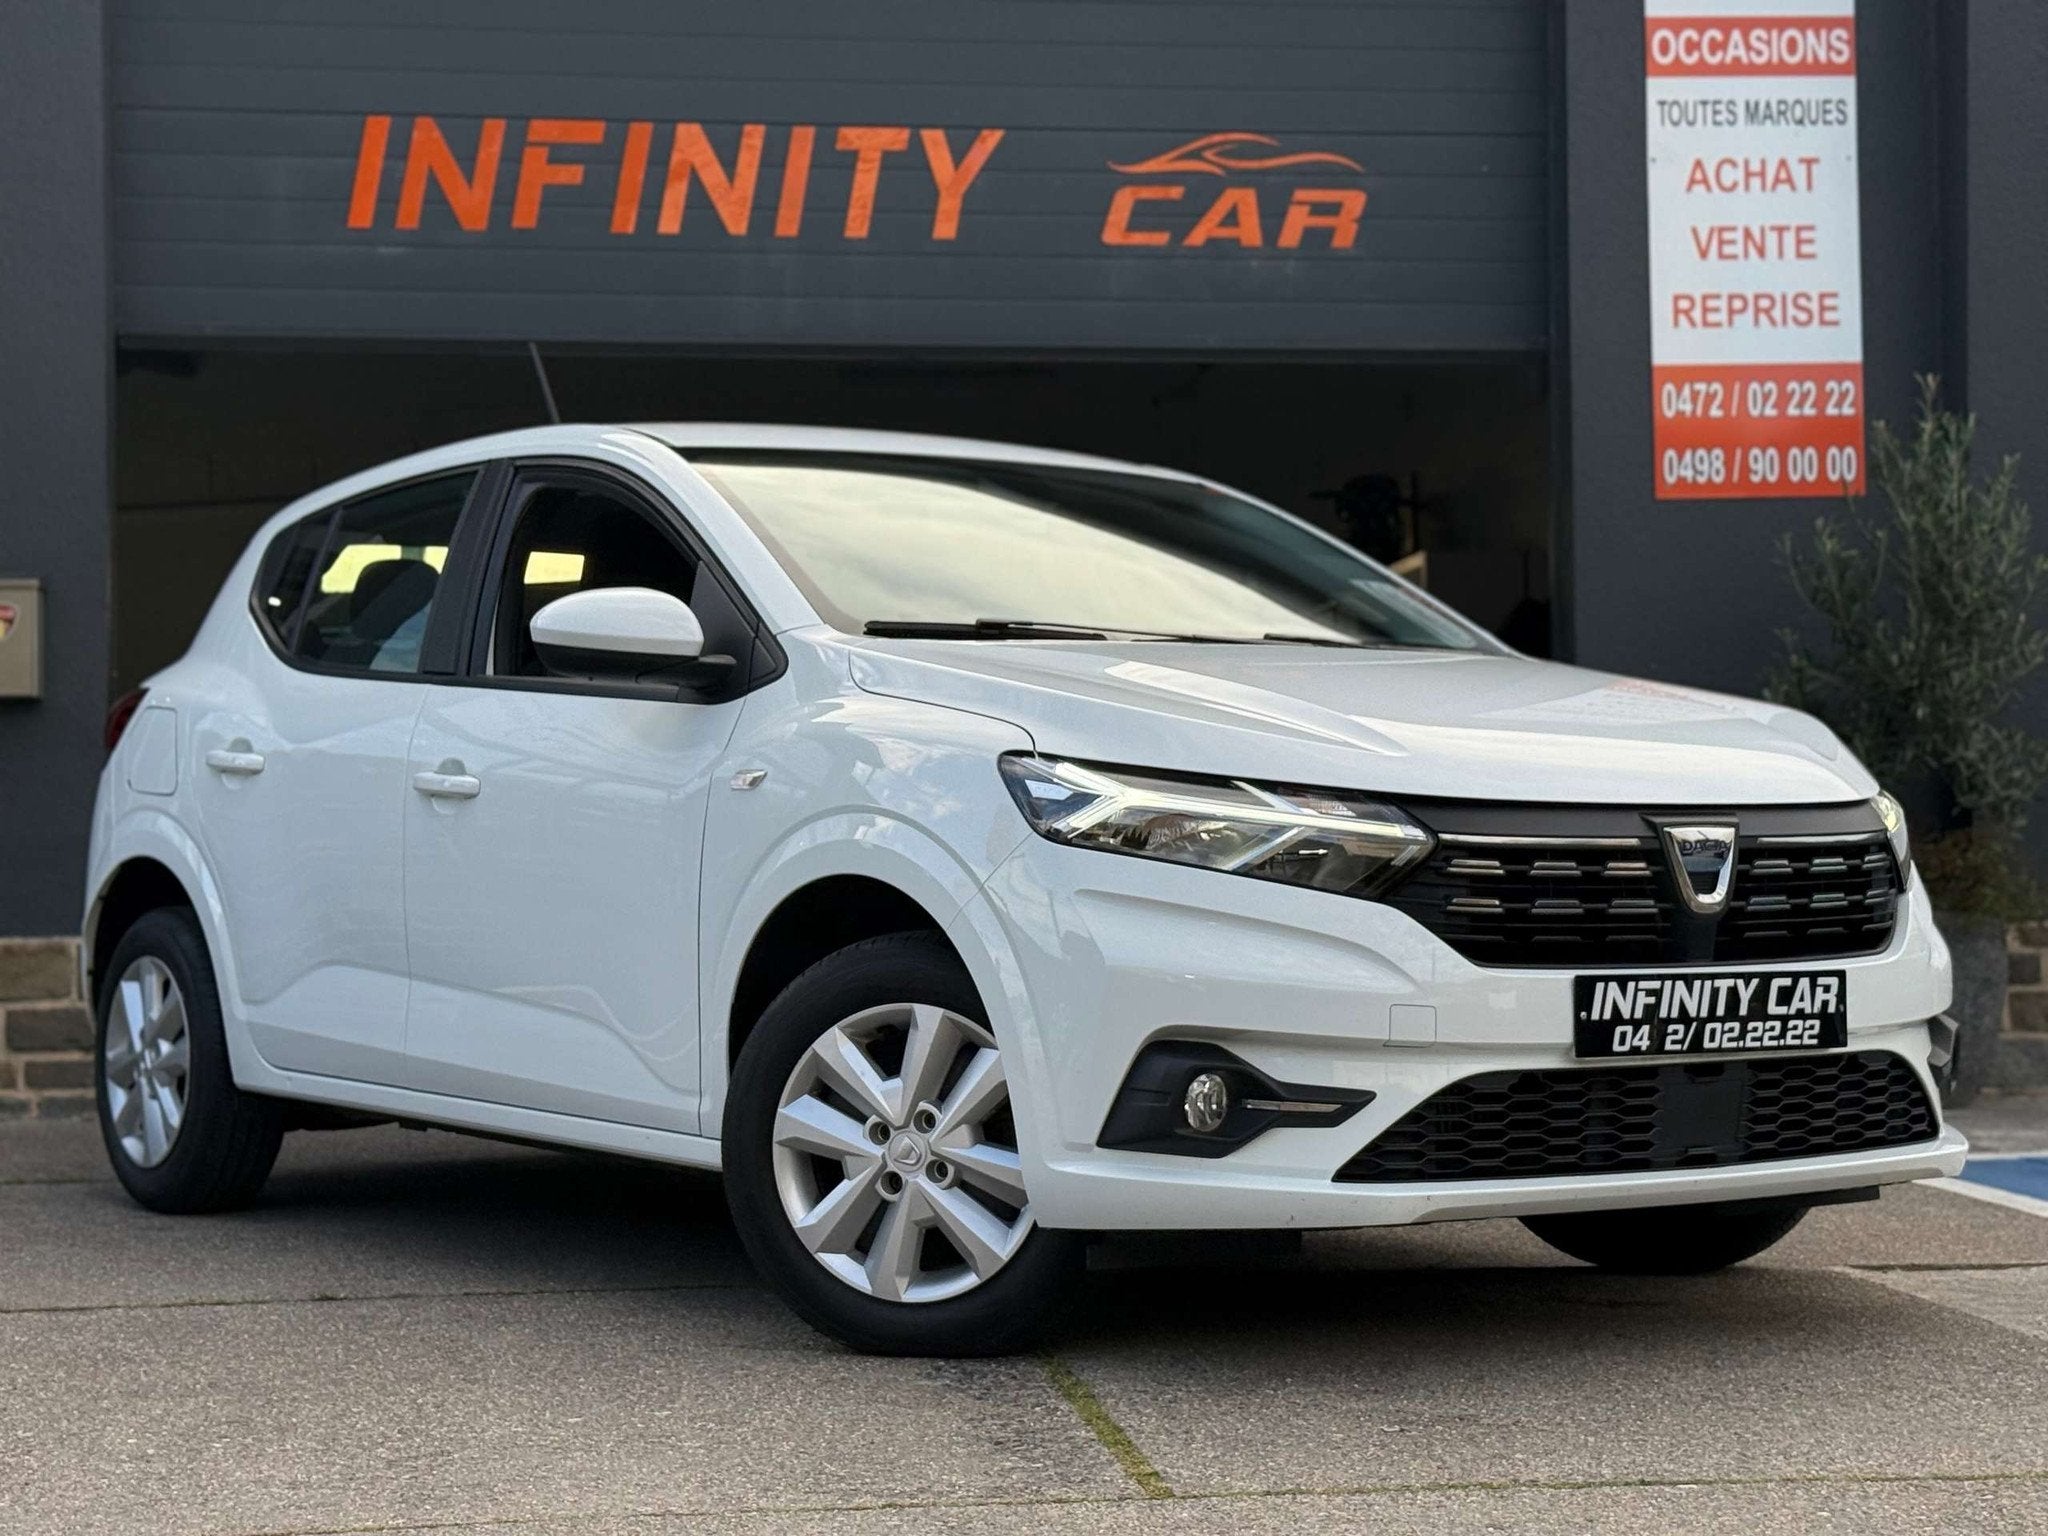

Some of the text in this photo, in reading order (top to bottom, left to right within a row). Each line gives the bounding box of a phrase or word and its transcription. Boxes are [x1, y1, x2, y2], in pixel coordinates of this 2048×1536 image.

[1651, 28, 1850, 66] OCCASIONS
[1657, 99, 1848, 127] TOUTES MARQUES
[347, 115, 1368, 248] INFINITY CAR
[1685, 157, 1820, 193] ACHAT
[1691, 225, 1818, 261] VENTE
[1672, 292, 1841, 329] REPRISE
[1661, 382, 1724, 418] 0472
[1747, 382, 1778, 417] 02
[1786, 381, 1817, 417] 22
[1825, 380, 1856, 416] 22
[1662, 448, 1725, 485] 0498
[1748, 448, 1780, 484] 90
[1787, 447, 1819, 483] 00
[1826, 446, 1858, 483] 00
[1591, 976, 1839, 1020] INFINITY CAR
[1703, 1019, 1821, 1049] 02.22.22
